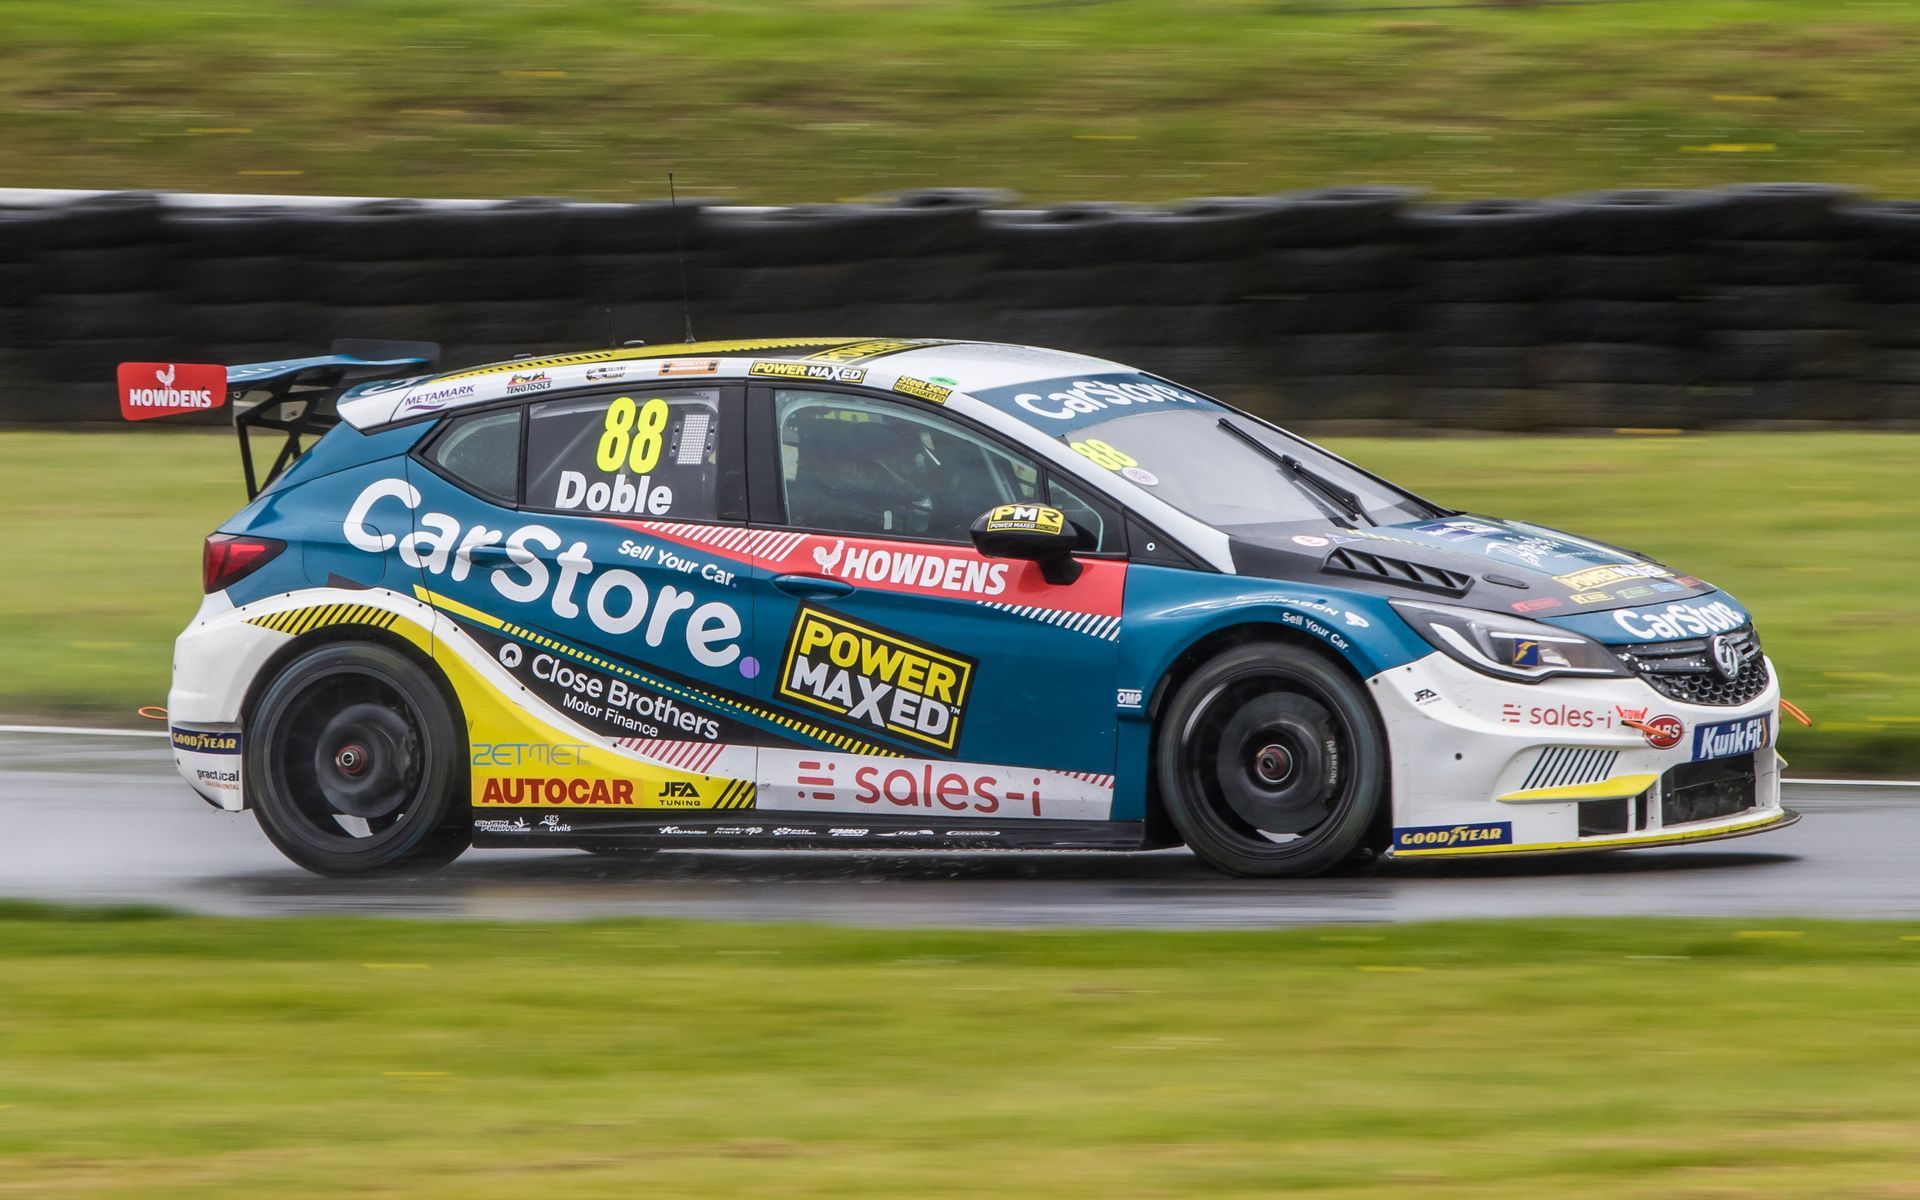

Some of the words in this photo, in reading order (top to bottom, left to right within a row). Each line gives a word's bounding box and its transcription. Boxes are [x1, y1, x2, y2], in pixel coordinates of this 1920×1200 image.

[753, 363, 807, 376] POWER
[808, 366, 862, 381] MAXED
[129, 389, 212, 408] HOWDENS
[404, 384, 475, 406] METAMARK
[899, 375, 927, 389] Steel
[926, 384, 952, 396] Seal
[596, 397, 669, 474] 88
[1069, 439, 1138, 471] 88
[555, 470, 673, 515] Doble
[994, 506, 1060, 523] PMR
[617, 539, 655, 562] Sell
[656, 551, 699, 576] Your
[840, 547, 1008, 595] HOWDENS
[1282, 612, 1303, 626] Sell
[1305, 619, 1330, 638] Your
[799, 619, 957, 704] POWER
[532, 653, 604, 699] Close
[610, 678, 720, 741] Brothers
[790, 655, 950, 737] MAXED
[1117, 692, 1142, 704] OMP
[563, 692, 603, 720] Motor
[604, 706, 659, 738] Finance
[1530, 703, 1612, 729] sales-i
[1623, 708, 1642, 719] TOW
[173, 733, 237, 751] GOODYEAR
[197, 769, 239, 782] practical
[481, 778, 634, 805] AUTOCAR
[658, 781, 700, 798] JFA
[854, 763, 1041, 817] sales-i
[549, 824, 572, 832] civils
[1400, 824, 1502, 846] GOODYEAR
